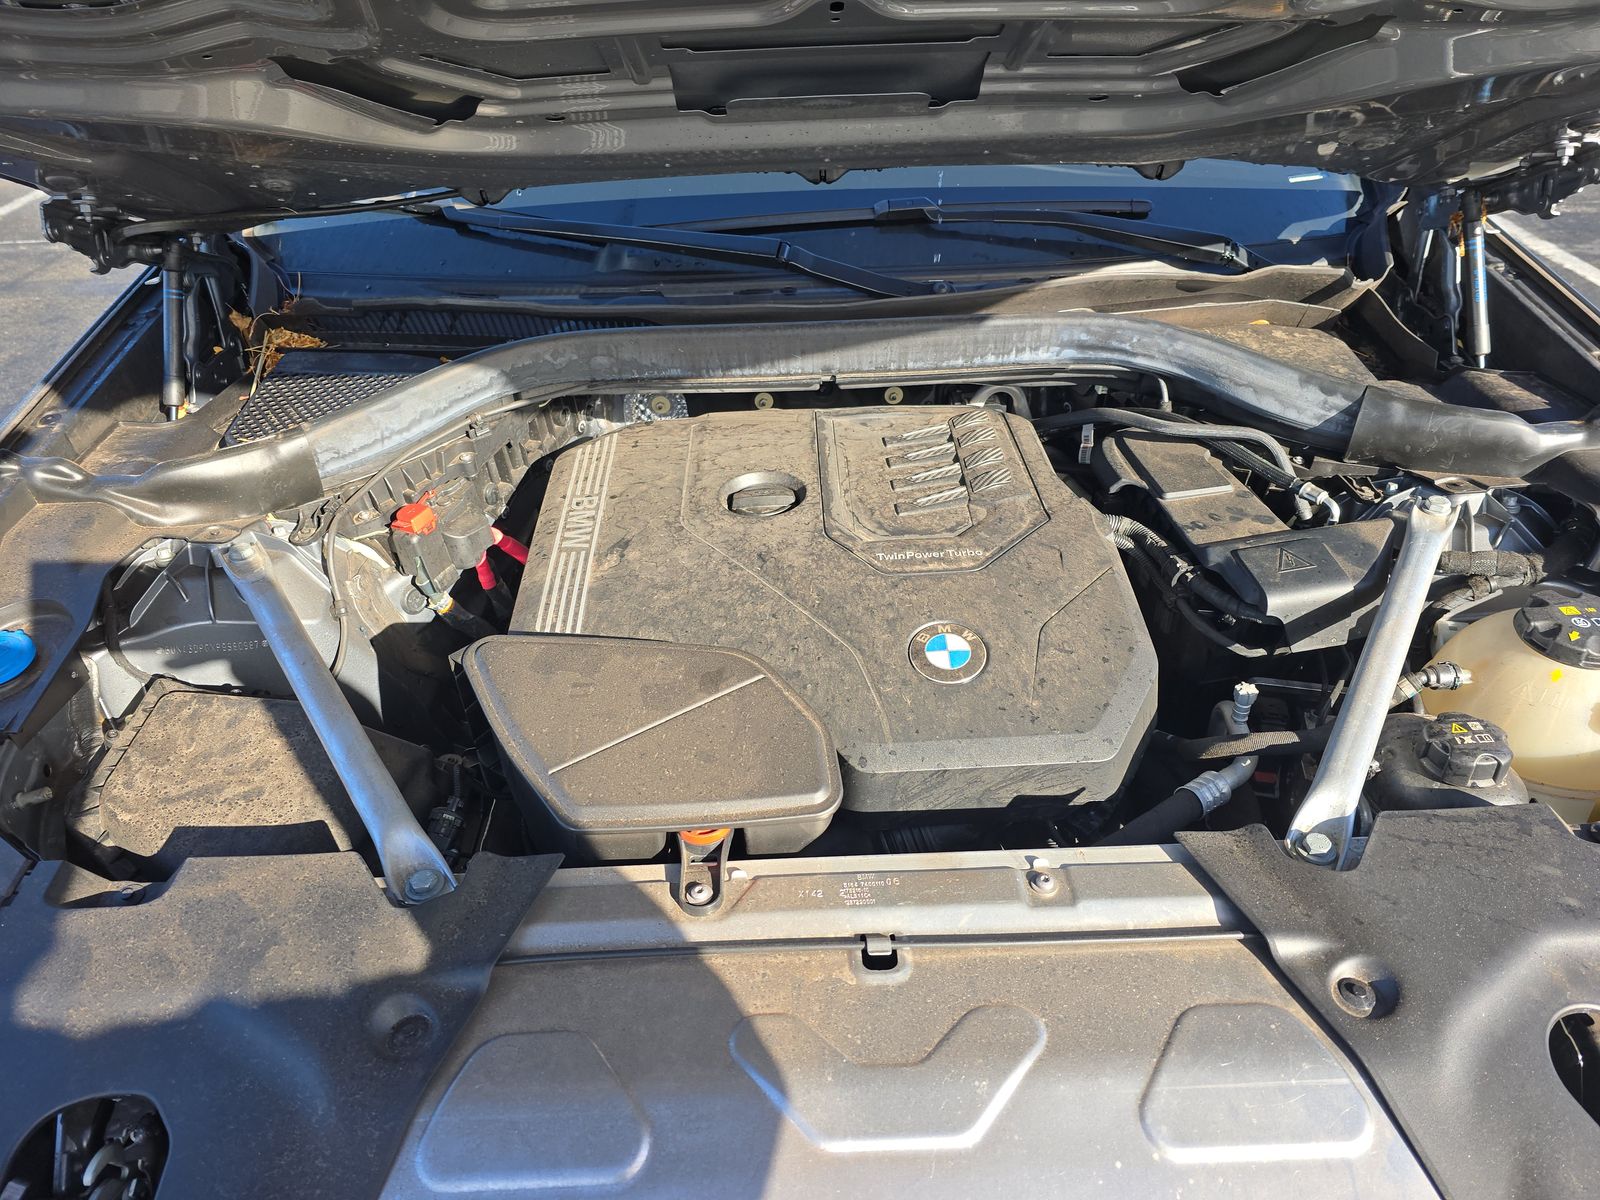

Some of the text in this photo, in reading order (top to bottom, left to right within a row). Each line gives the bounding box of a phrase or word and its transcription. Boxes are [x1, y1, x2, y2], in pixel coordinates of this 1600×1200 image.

[561, 496, 599, 548] BMW
[876, 548, 983, 561] TwinPower Turbo
[916, 624, 977, 643] BMW
